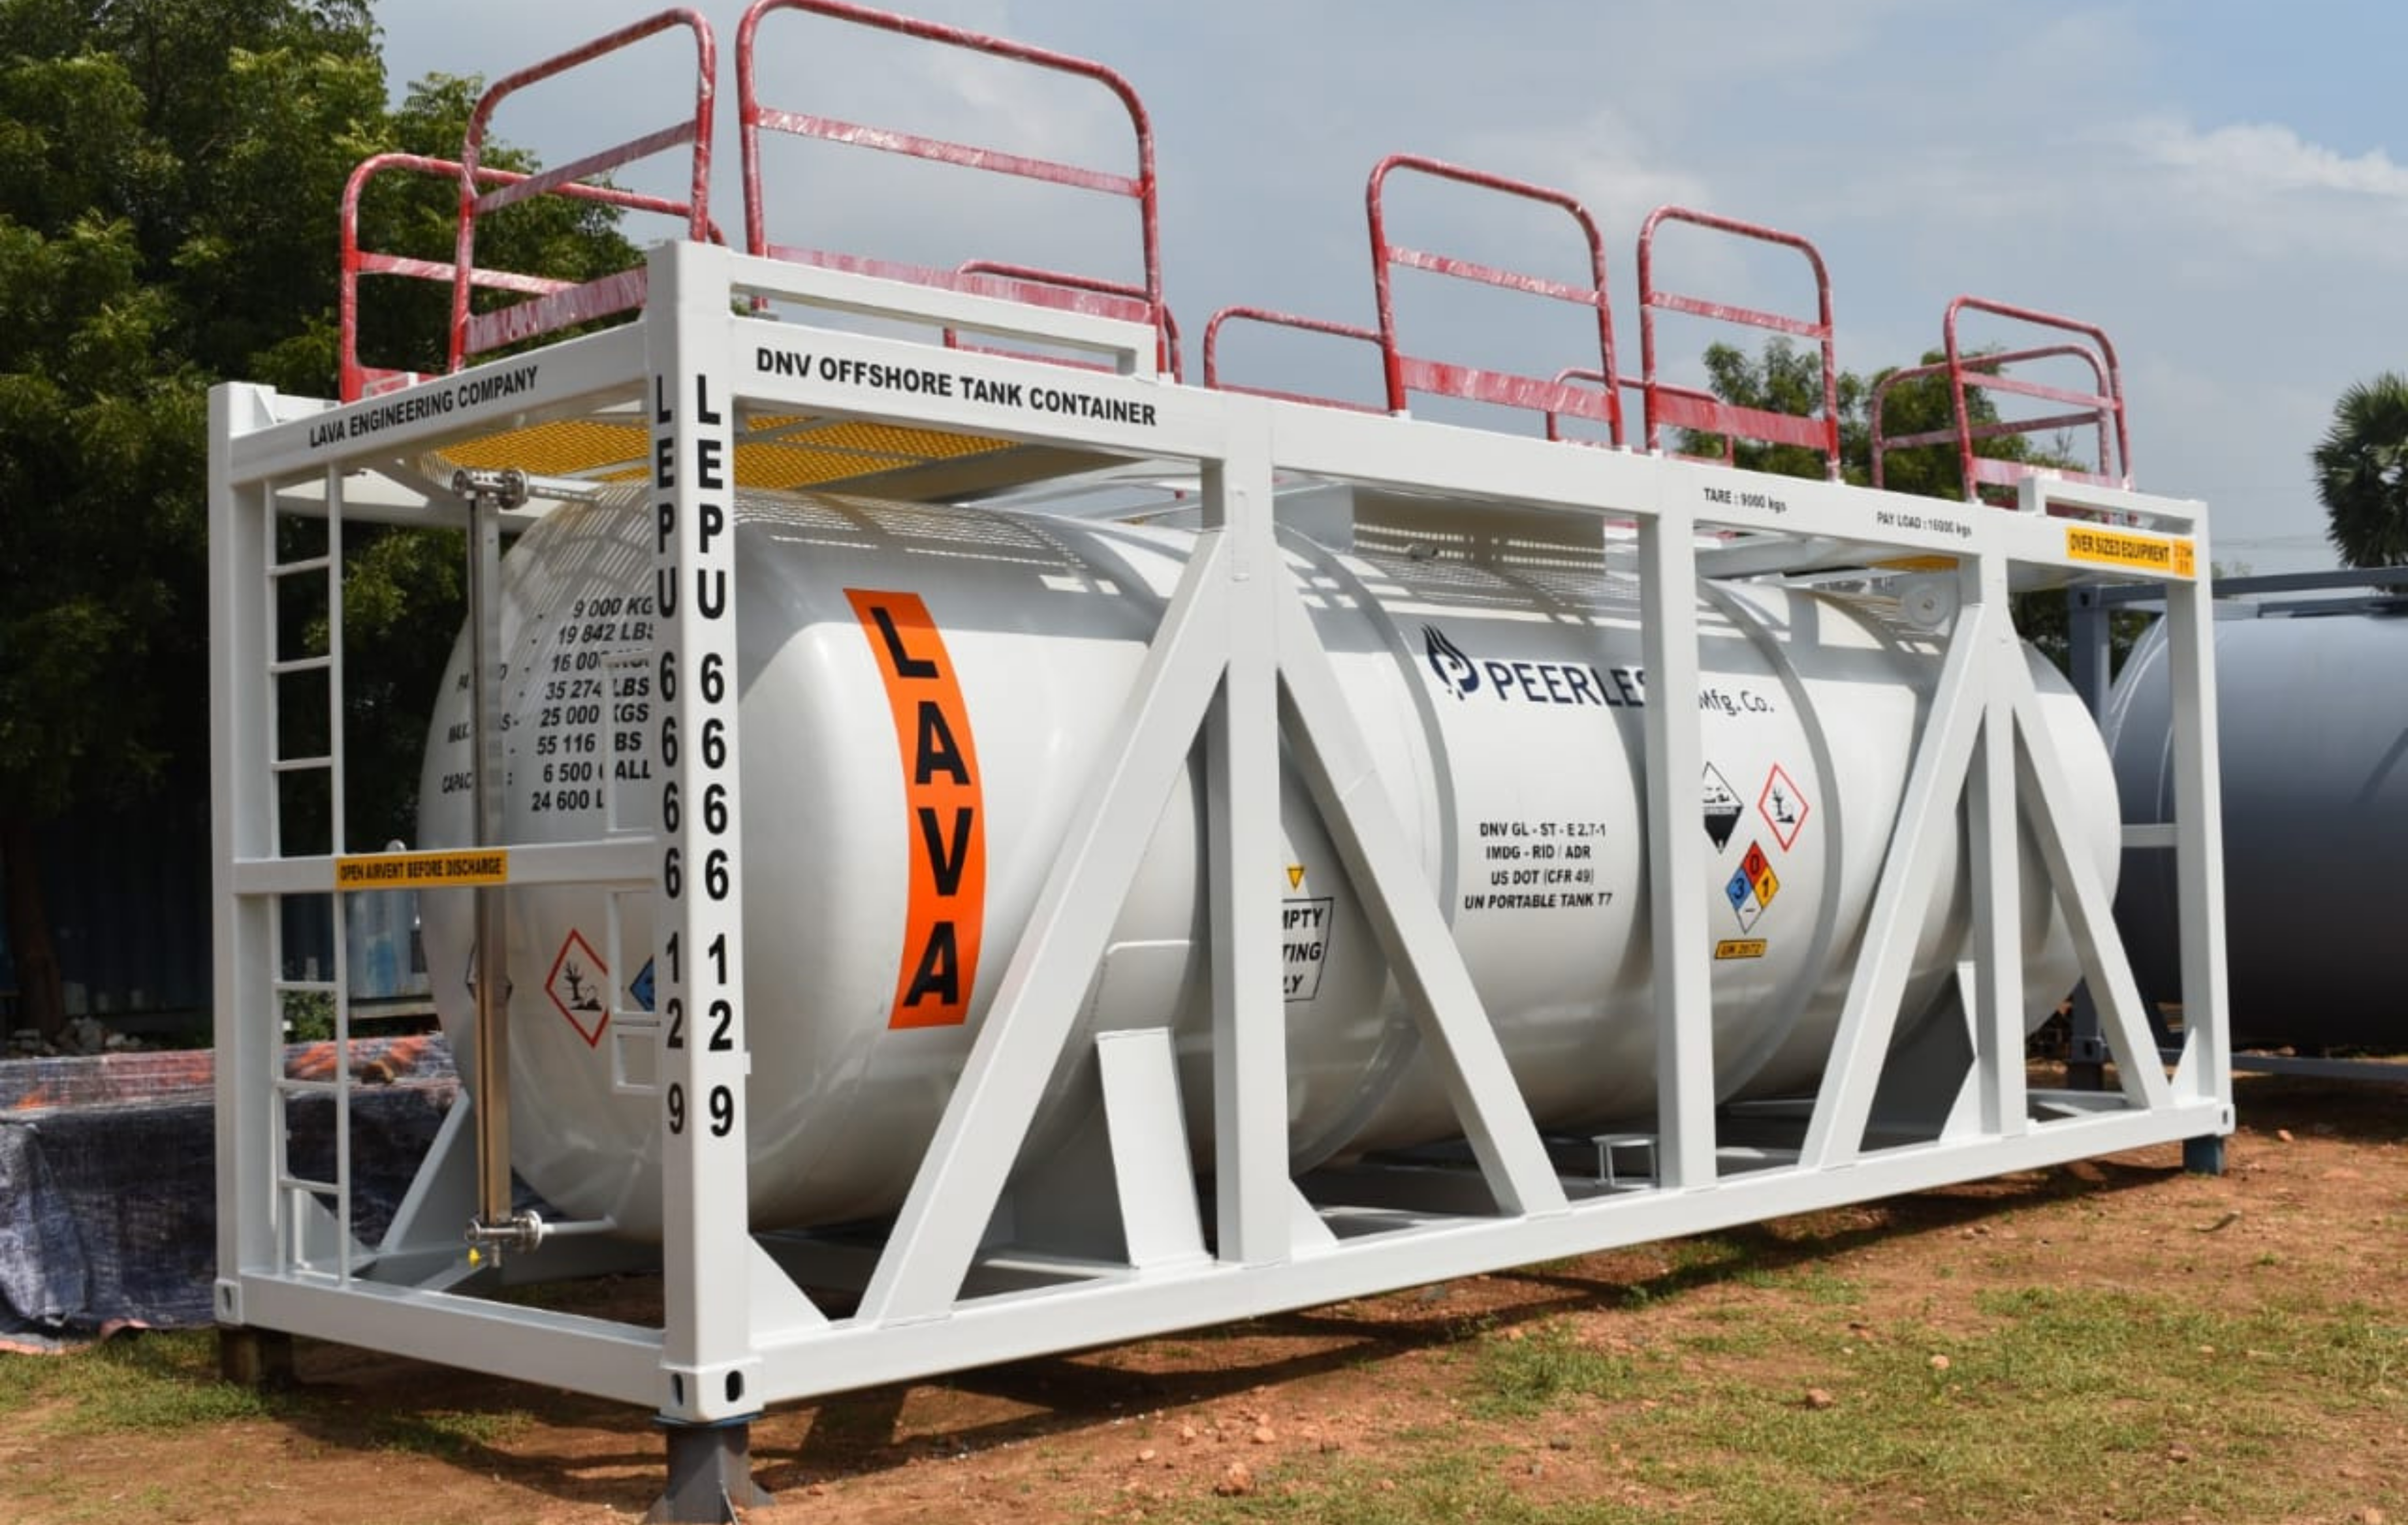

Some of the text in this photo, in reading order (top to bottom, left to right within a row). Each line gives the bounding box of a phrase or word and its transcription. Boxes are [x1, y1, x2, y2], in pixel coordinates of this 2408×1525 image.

[757, 347, 1156, 426] DNV OFFSHORE TANK CONTAINER
[310, 366, 537, 447] LAVA ENGINEERING COMPANY
[697, 374, 725, 619] LEPU
[1704, 487, 1731, 504] TARE
[1742, 493, 1765, 508] 9000
[1769, 495, 1786, 513] kgs
[1877, 511, 1894, 524] PAY
[1898, 513, 1921, 528] LOAD
[1956, 522, 1972, 538] kgs
[2070, 533, 2092, 551] OVER
[2096, 536, 2120, 555] SIZED
[2122, 540, 2169, 562] EQUIPMENT
[573, 597, 653, 618] 9 000 KG
[559, 625, 577, 645] 19
[581, 623, 615, 643] 842
[553, 653, 572, 672] 16
[576, 650, 610, 670] 00
[545, 681, 567, 700] 35
[570, 679, 602, 698] 274
[1483, 661, 1646, 707] PEERLE
[540, 707, 561, 727] 25
[566, 705, 599, 724] 000
[536, 735, 557, 755] 55
[563, 733, 595, 753] 116
[657, 374, 677, 619] LEPU
[667, 1083, 684, 1134] 9
[543, 763, 554, 783] 6
[559, 762, 592, 782] 500
[531, 791, 550, 811] 24
[557, 789, 589, 811] 600
[870, 606, 974, 1007] LAVA
[1480, 822, 1507, 837] DNV
[1512, 822, 1529, 836] GL
[1540, 822, 1556, 837] ST
[1486, 845, 1520, 860] IMDG
[1532, 844, 1554, 859] RID
[1565, 845, 1590, 859] ADR
[340, 857, 500, 881] OPEN AIRVENT BEFORE DISCHARGE
[1750, 854, 1760, 875] 0
[1491, 870, 1508, 885] US
[1512, 870, 1540, 884] DOT
[1544, 867, 1572, 886] (CFR
[1762, 877, 1769, 898] 1
[1734, 878, 1745, 900] 3
[1465, 893, 1613, 909] UN PORTABLE TANK T7
[709, 1085, 733, 1137] 9
